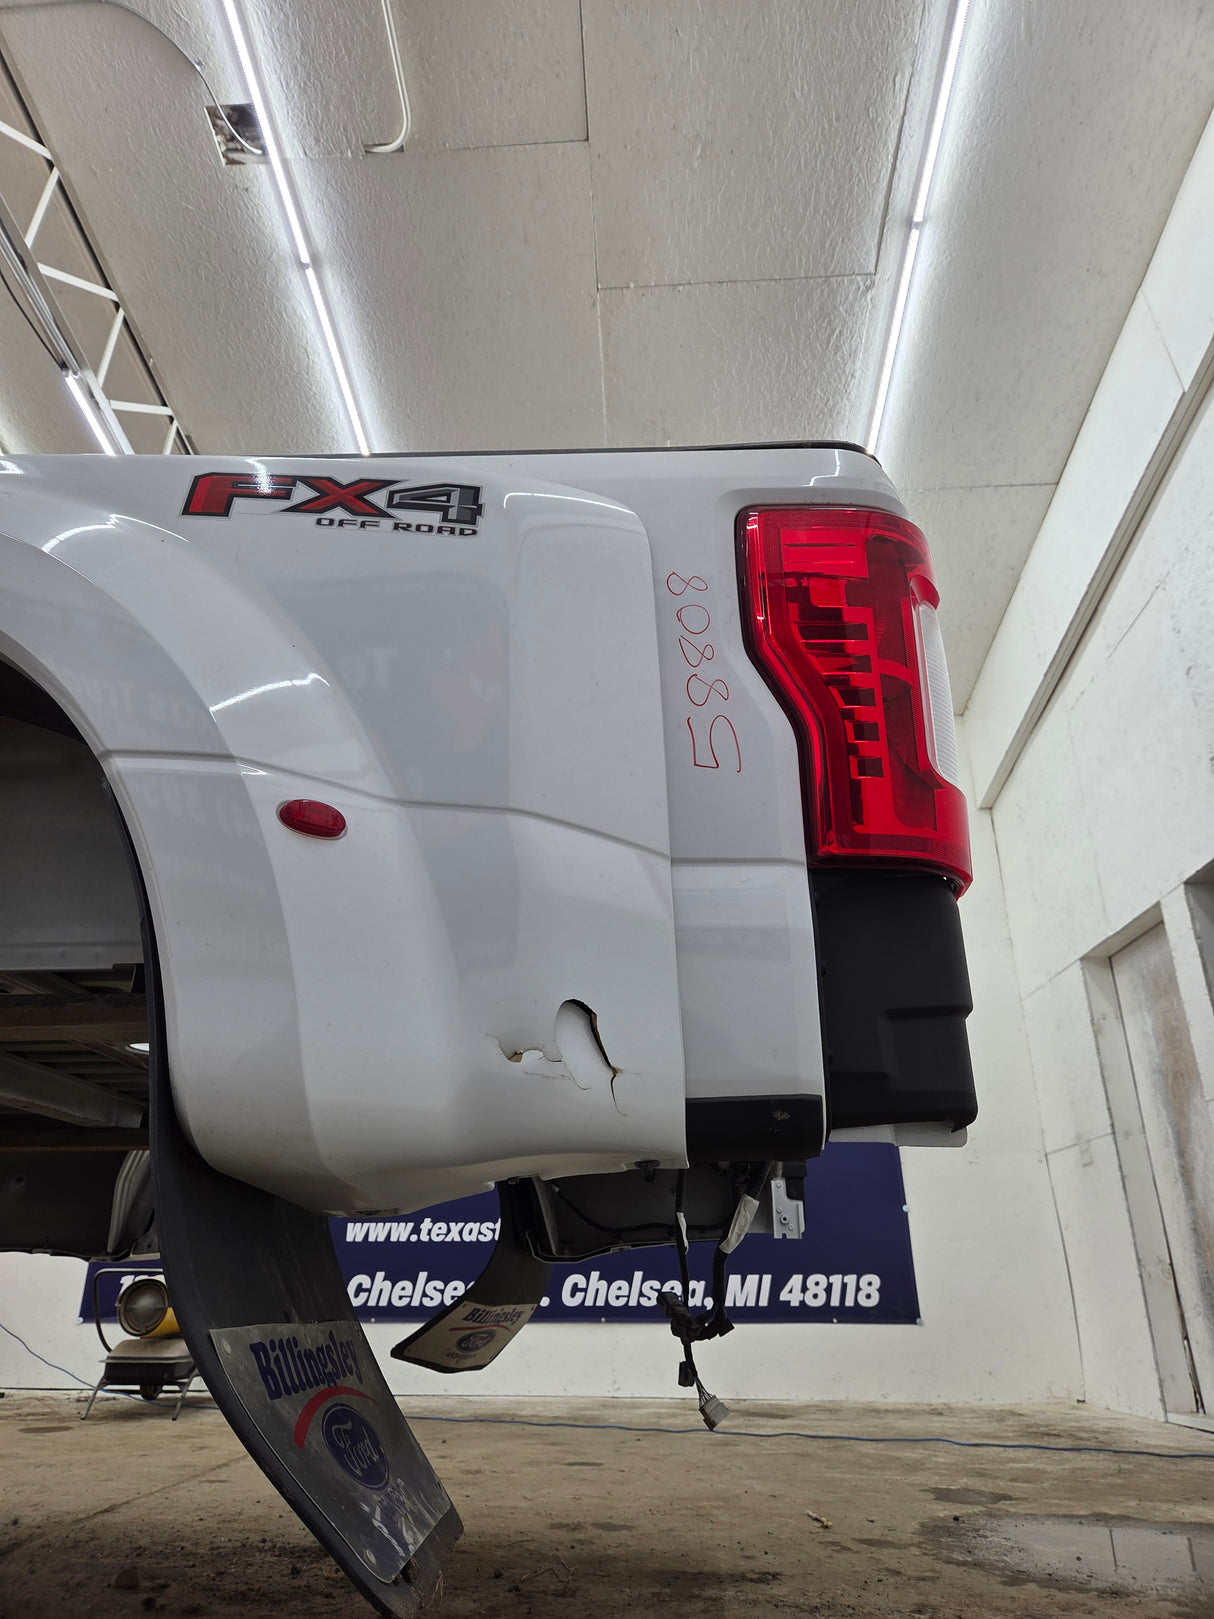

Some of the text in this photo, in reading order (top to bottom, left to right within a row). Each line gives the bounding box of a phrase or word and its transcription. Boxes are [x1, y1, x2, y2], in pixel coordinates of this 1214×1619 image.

[181, 472, 483, 526] FX4
[315, 517, 478, 536] OFF ROAD
[666, 571, 742, 773] 58808
[346, 1271, 475, 1307] Chelse
[725, 1274, 772, 1307] MI
[779, 1273, 881, 1307] 48118
[250, 1330, 363, 1401] Billingsley
[331, 1420, 386, 1477] Ford
